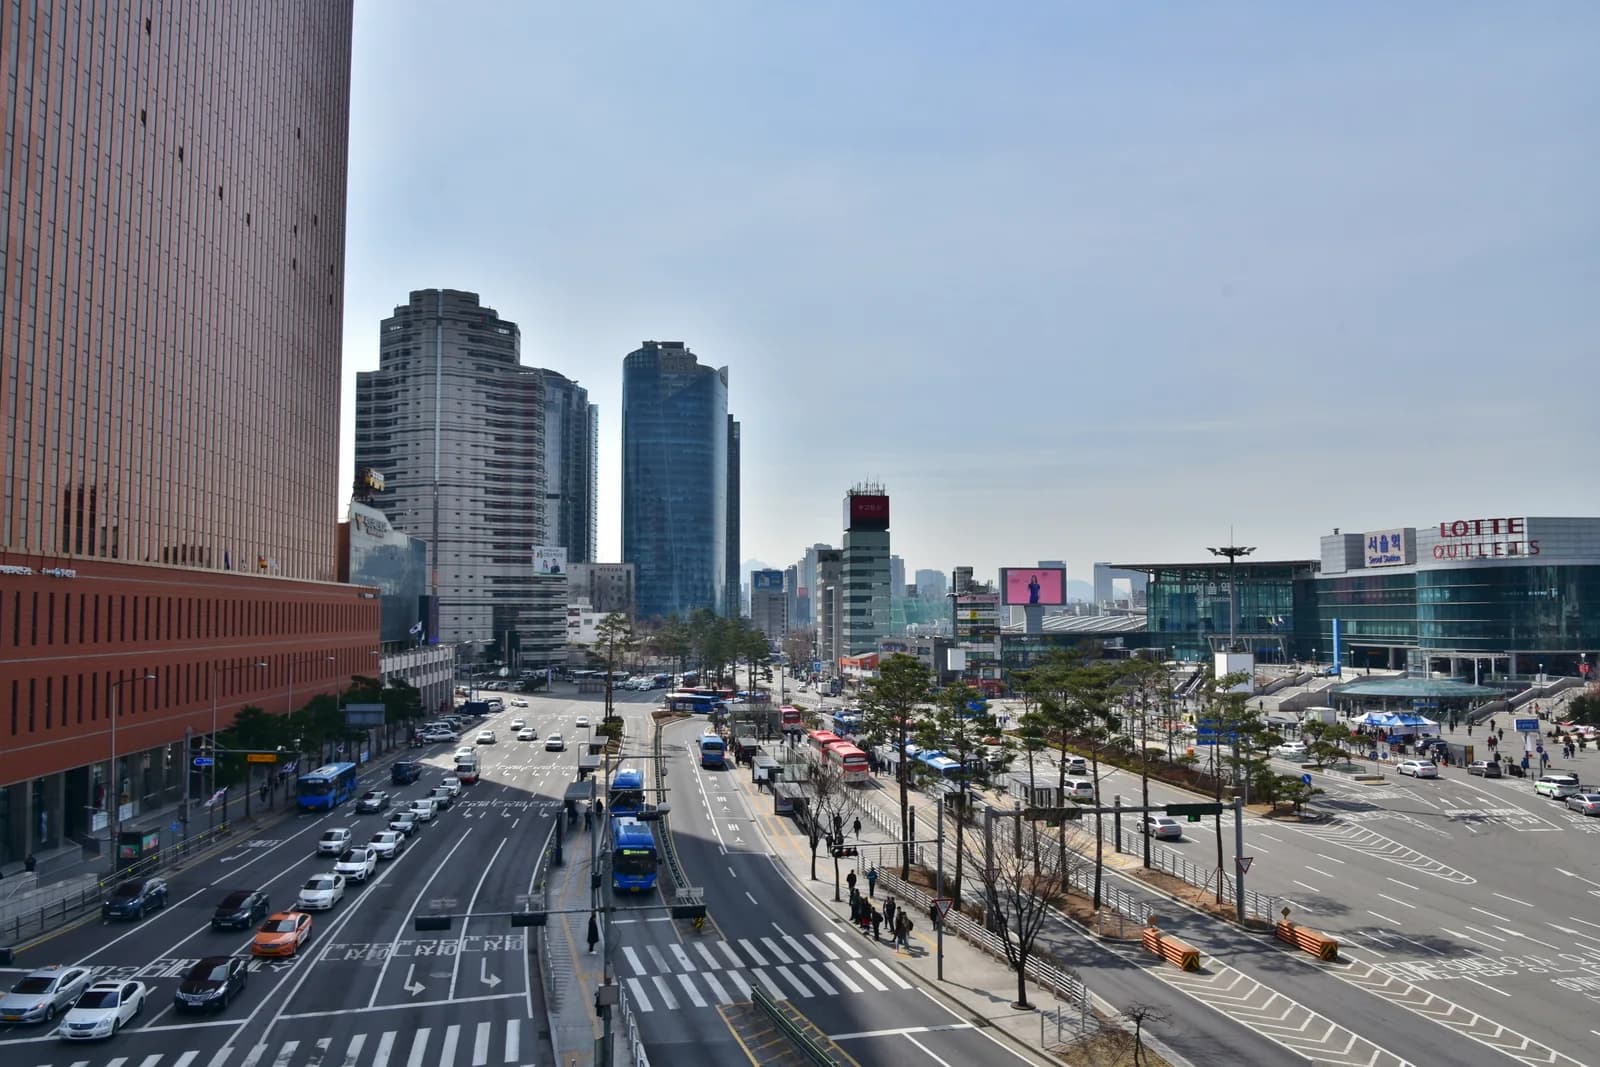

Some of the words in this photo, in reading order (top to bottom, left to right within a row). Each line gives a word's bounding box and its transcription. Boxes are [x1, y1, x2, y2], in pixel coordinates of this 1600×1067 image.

[1440, 518, 1524, 538] LOTTE
[1368, 533, 1401, 553] 서울역
[1433, 540, 1541, 559] OUTLETS
[137, 959, 201, 977] 례문
